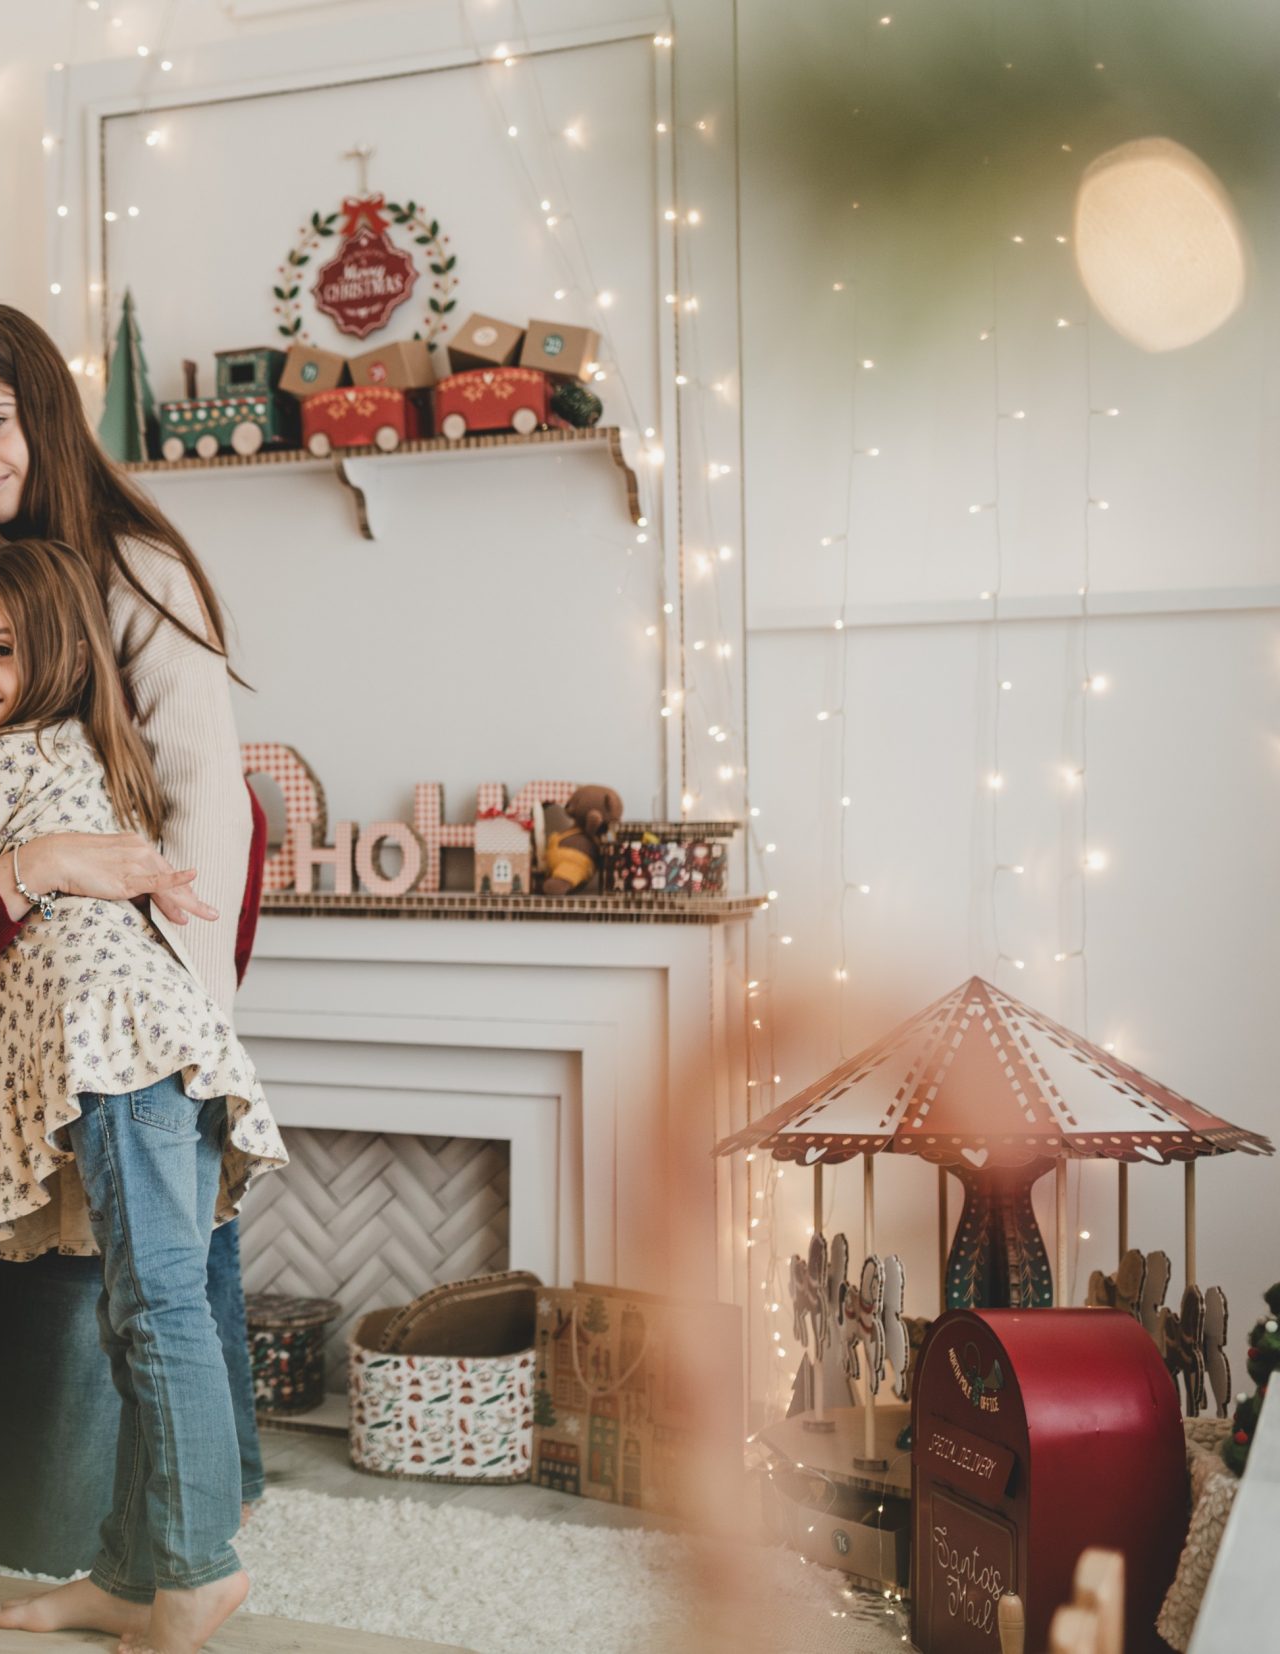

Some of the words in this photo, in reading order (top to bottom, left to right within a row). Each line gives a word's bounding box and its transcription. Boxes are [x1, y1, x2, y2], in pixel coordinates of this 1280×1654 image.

[947, 1347, 963, 1380] NORTH
[959, 1375, 973, 1400] POLE
[980, 1395, 1000, 1413] OFFICE
[932, 1525, 1004, 1601] Santa's
[946, 1574, 995, 1635] Mail
